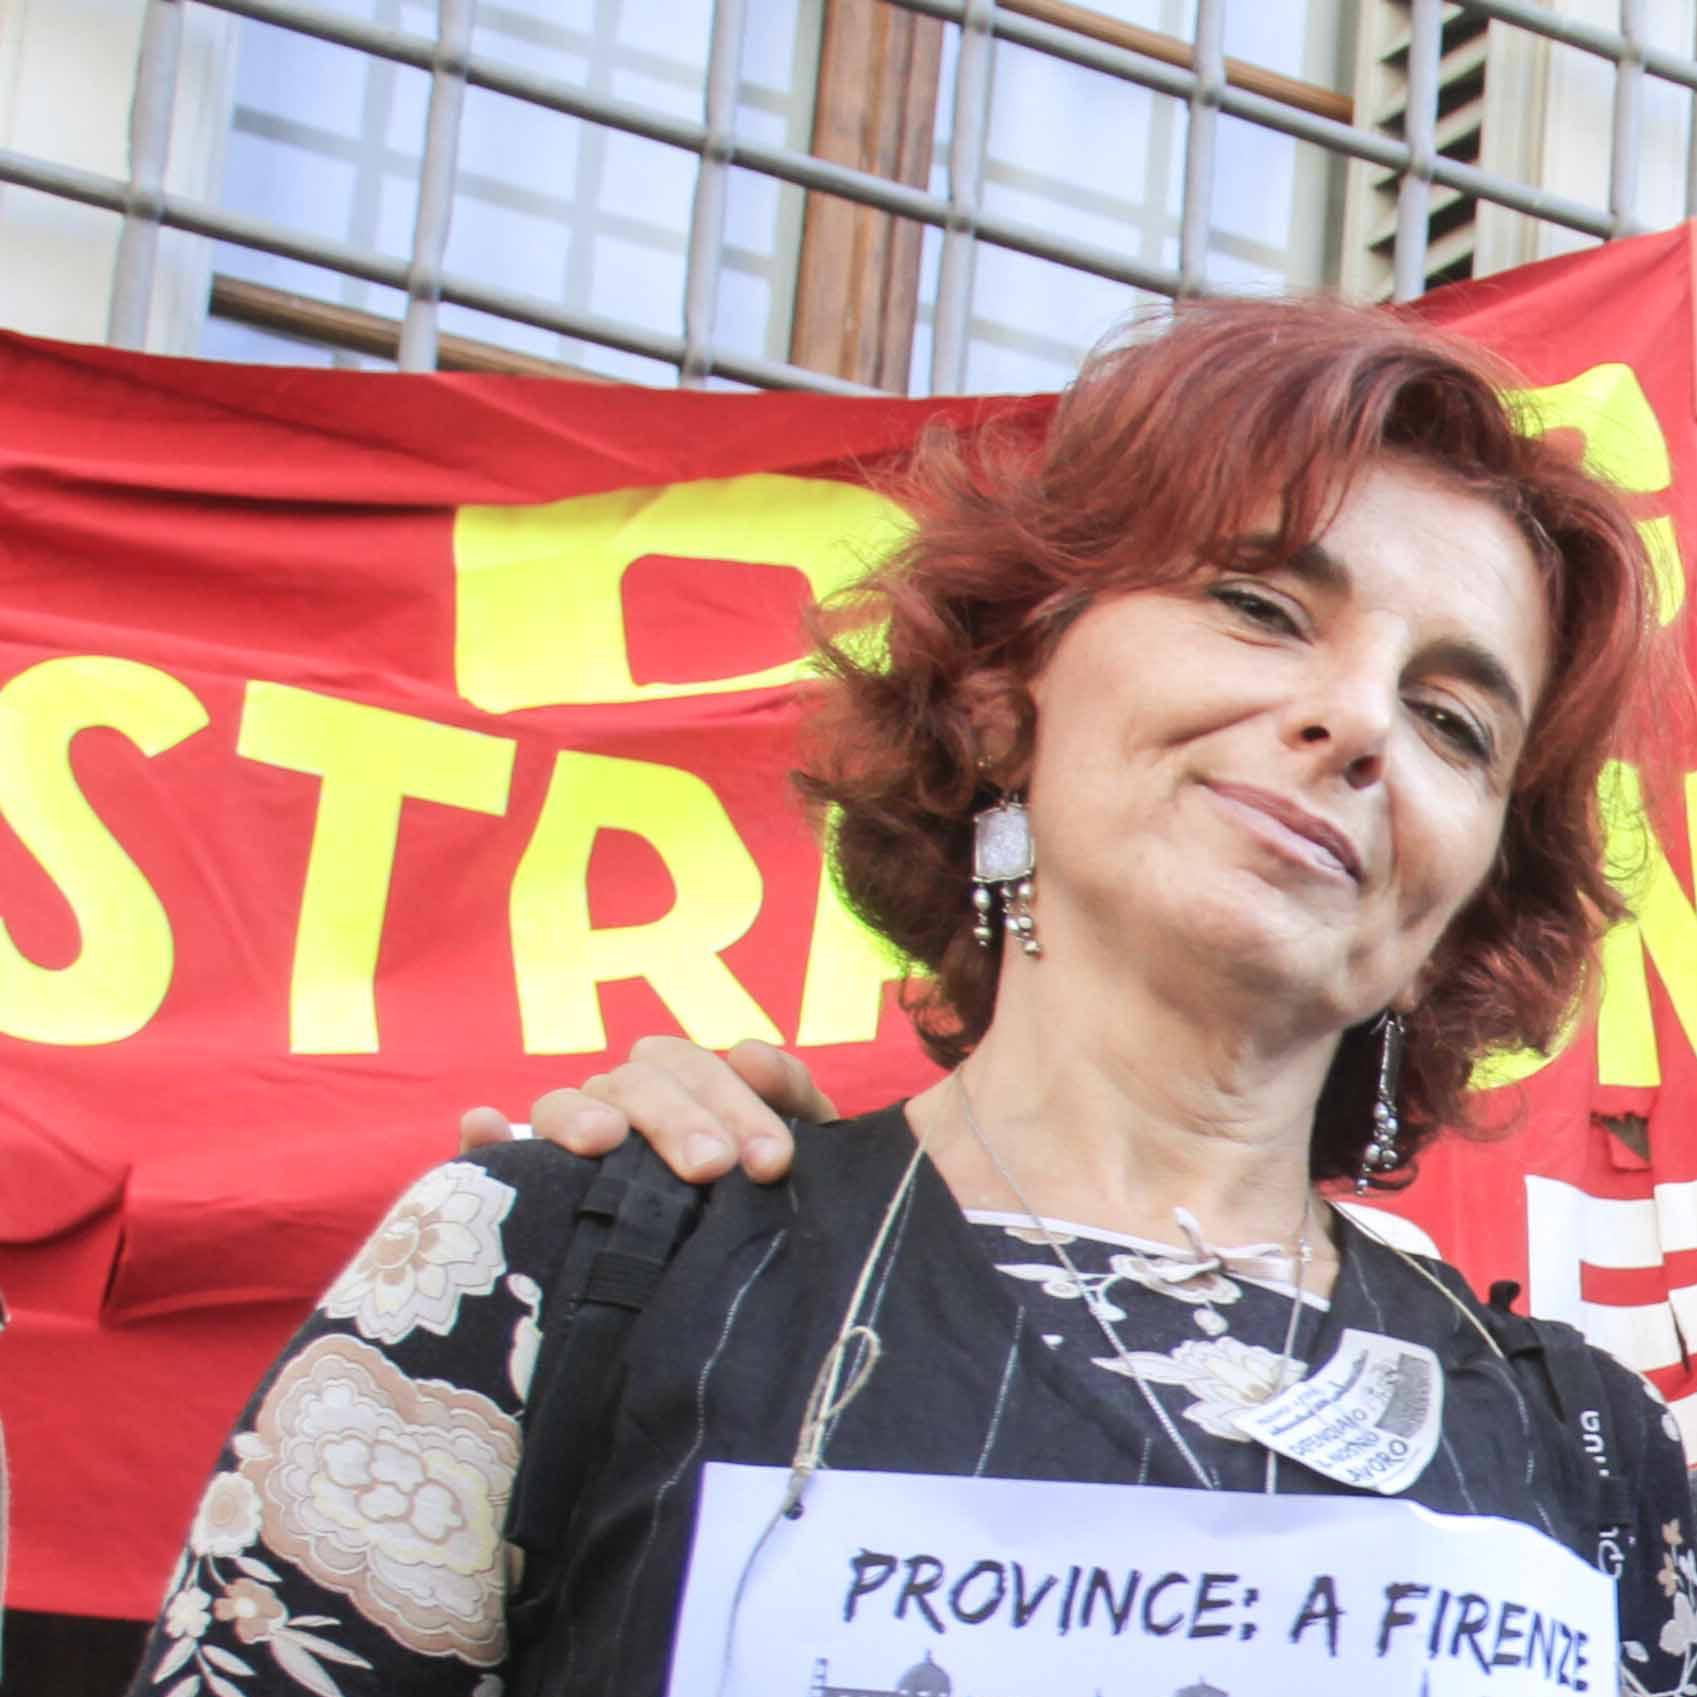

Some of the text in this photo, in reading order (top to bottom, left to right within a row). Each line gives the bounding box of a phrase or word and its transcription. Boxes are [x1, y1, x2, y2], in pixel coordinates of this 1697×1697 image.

[843, 1548, 1590, 1693] PROVINCE: A FIRENZE
